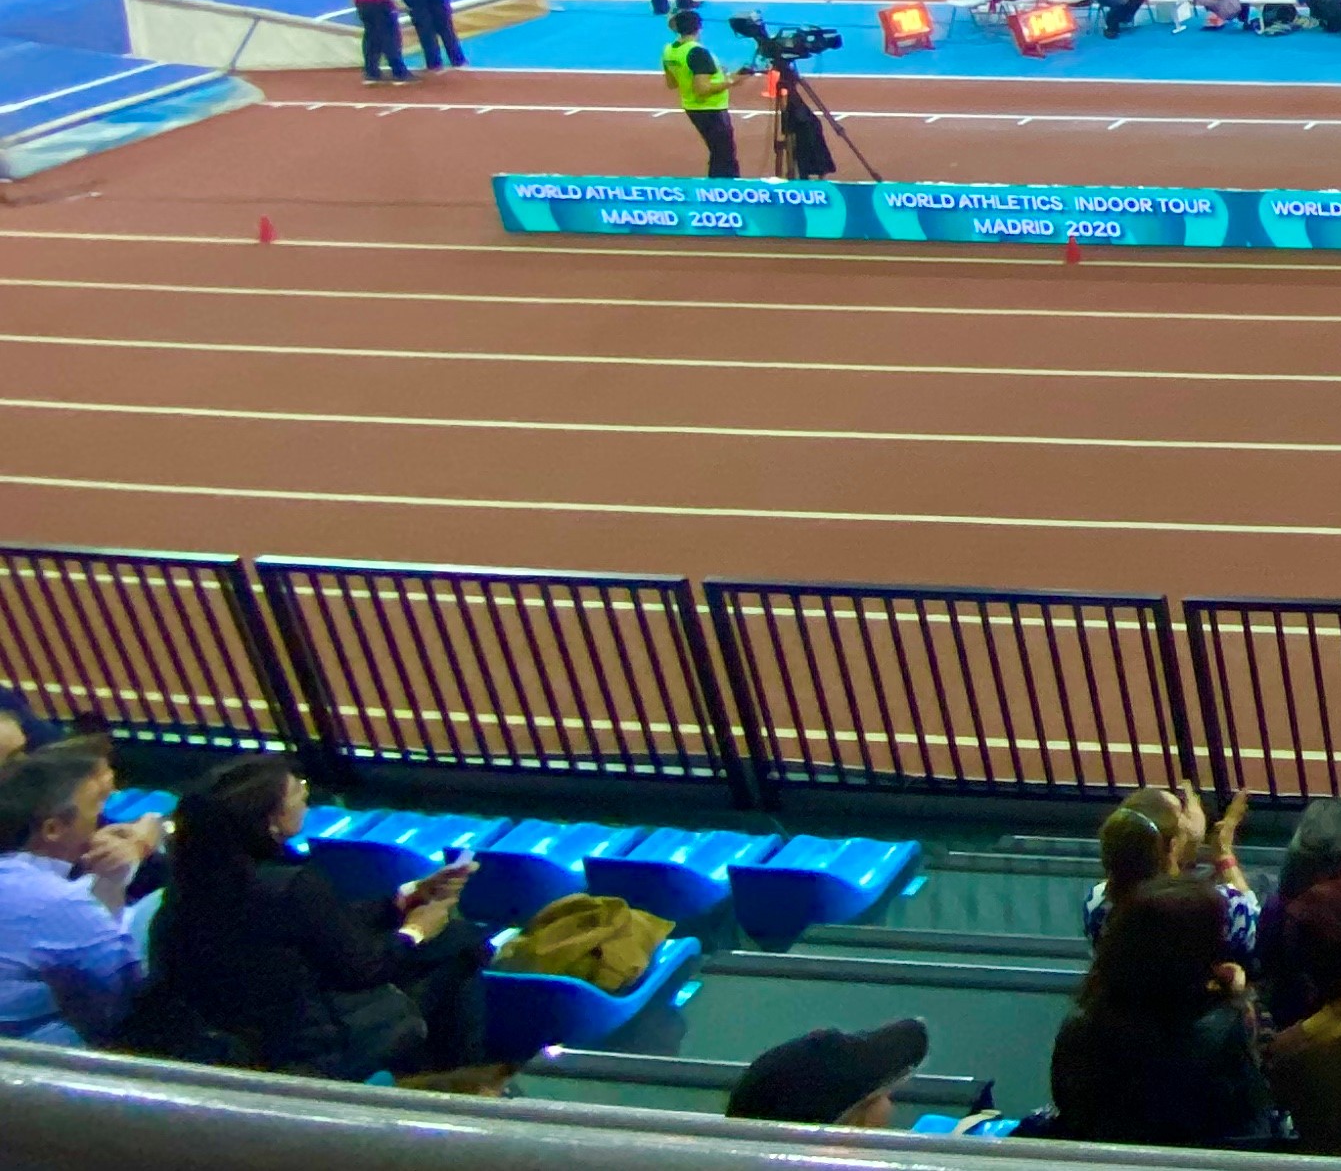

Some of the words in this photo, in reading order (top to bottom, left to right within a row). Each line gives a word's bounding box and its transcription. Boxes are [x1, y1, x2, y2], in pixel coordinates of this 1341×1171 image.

[513, 184, 582, 199] WORLD
[585, 186, 685, 202] ATHLETICS
[695, 188, 771, 204] INDOOR
[776, 189, 828, 205] TOUR
[885, 192, 955, 208] WORLD
[958, 194, 1063, 211] ATHLETICS
[1075, 196, 1153, 213] INDOOR
[1157, 197, 1212, 214] TOUR
[601, 209, 679, 226] MADRID
[690, 212, 743, 227] 2020
[974, 218, 1054, 235] MADRID
[1066, 220, 1121, 237] 2020
